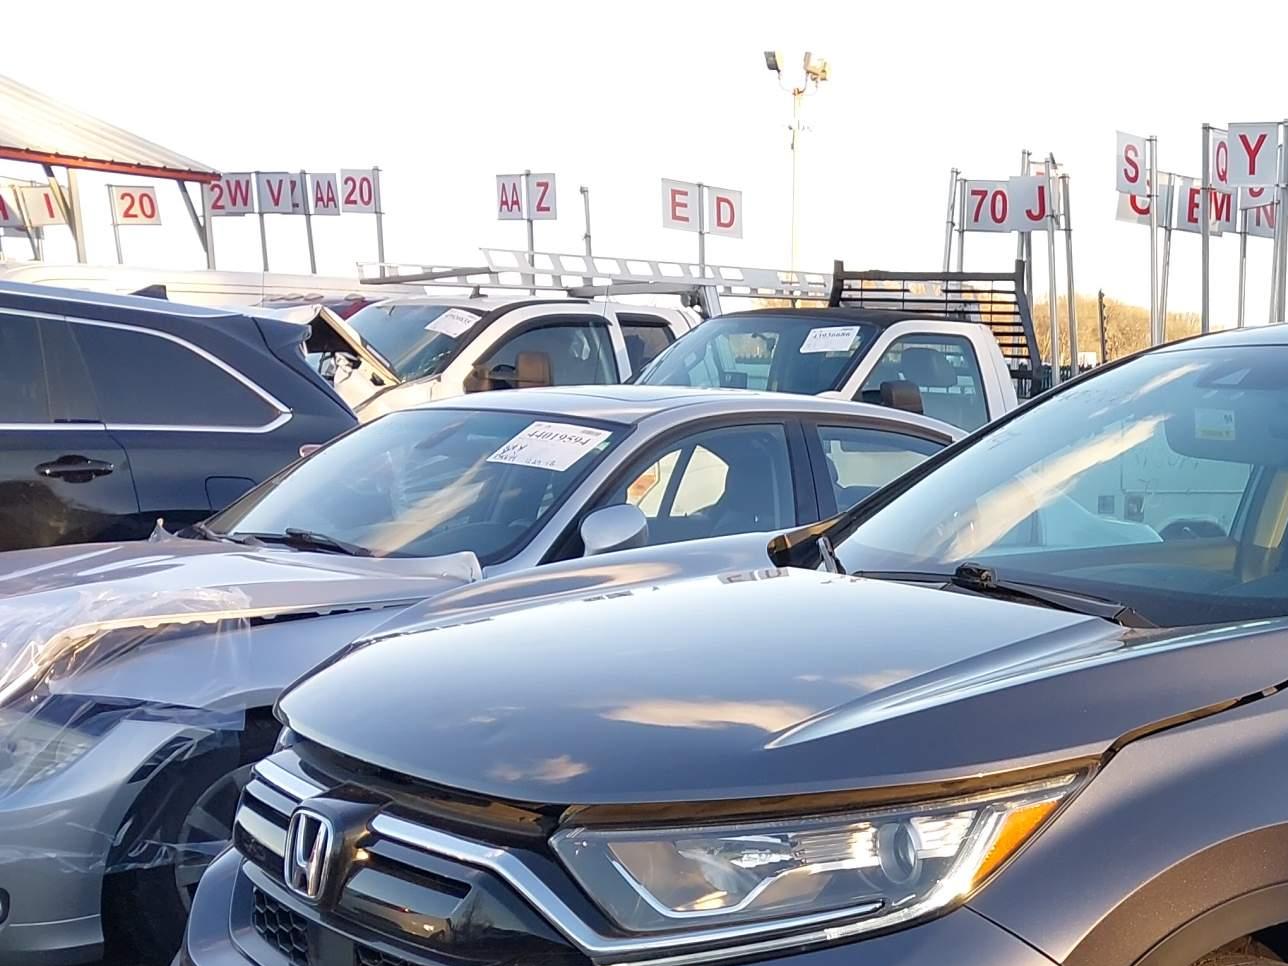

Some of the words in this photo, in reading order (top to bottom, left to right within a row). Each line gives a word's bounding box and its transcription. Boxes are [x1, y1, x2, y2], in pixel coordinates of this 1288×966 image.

[1123, 144, 1139, 184] S
[1215, 141, 1228, 185] Q
[1238, 133, 1268, 176] Y
[119, 190, 157, 220] 20
[265, 178, 284, 207] V
[314, 180, 338, 209] AA
[343, 176, 373, 206] 20
[499, 182, 521, 213] AA
[535, 181, 551, 212] Z
[670, 188, 690, 222] E
[970, 189, 1008, 224] 70
[1025, 185, 1046, 222] J
[715, 196, 736, 228] D
